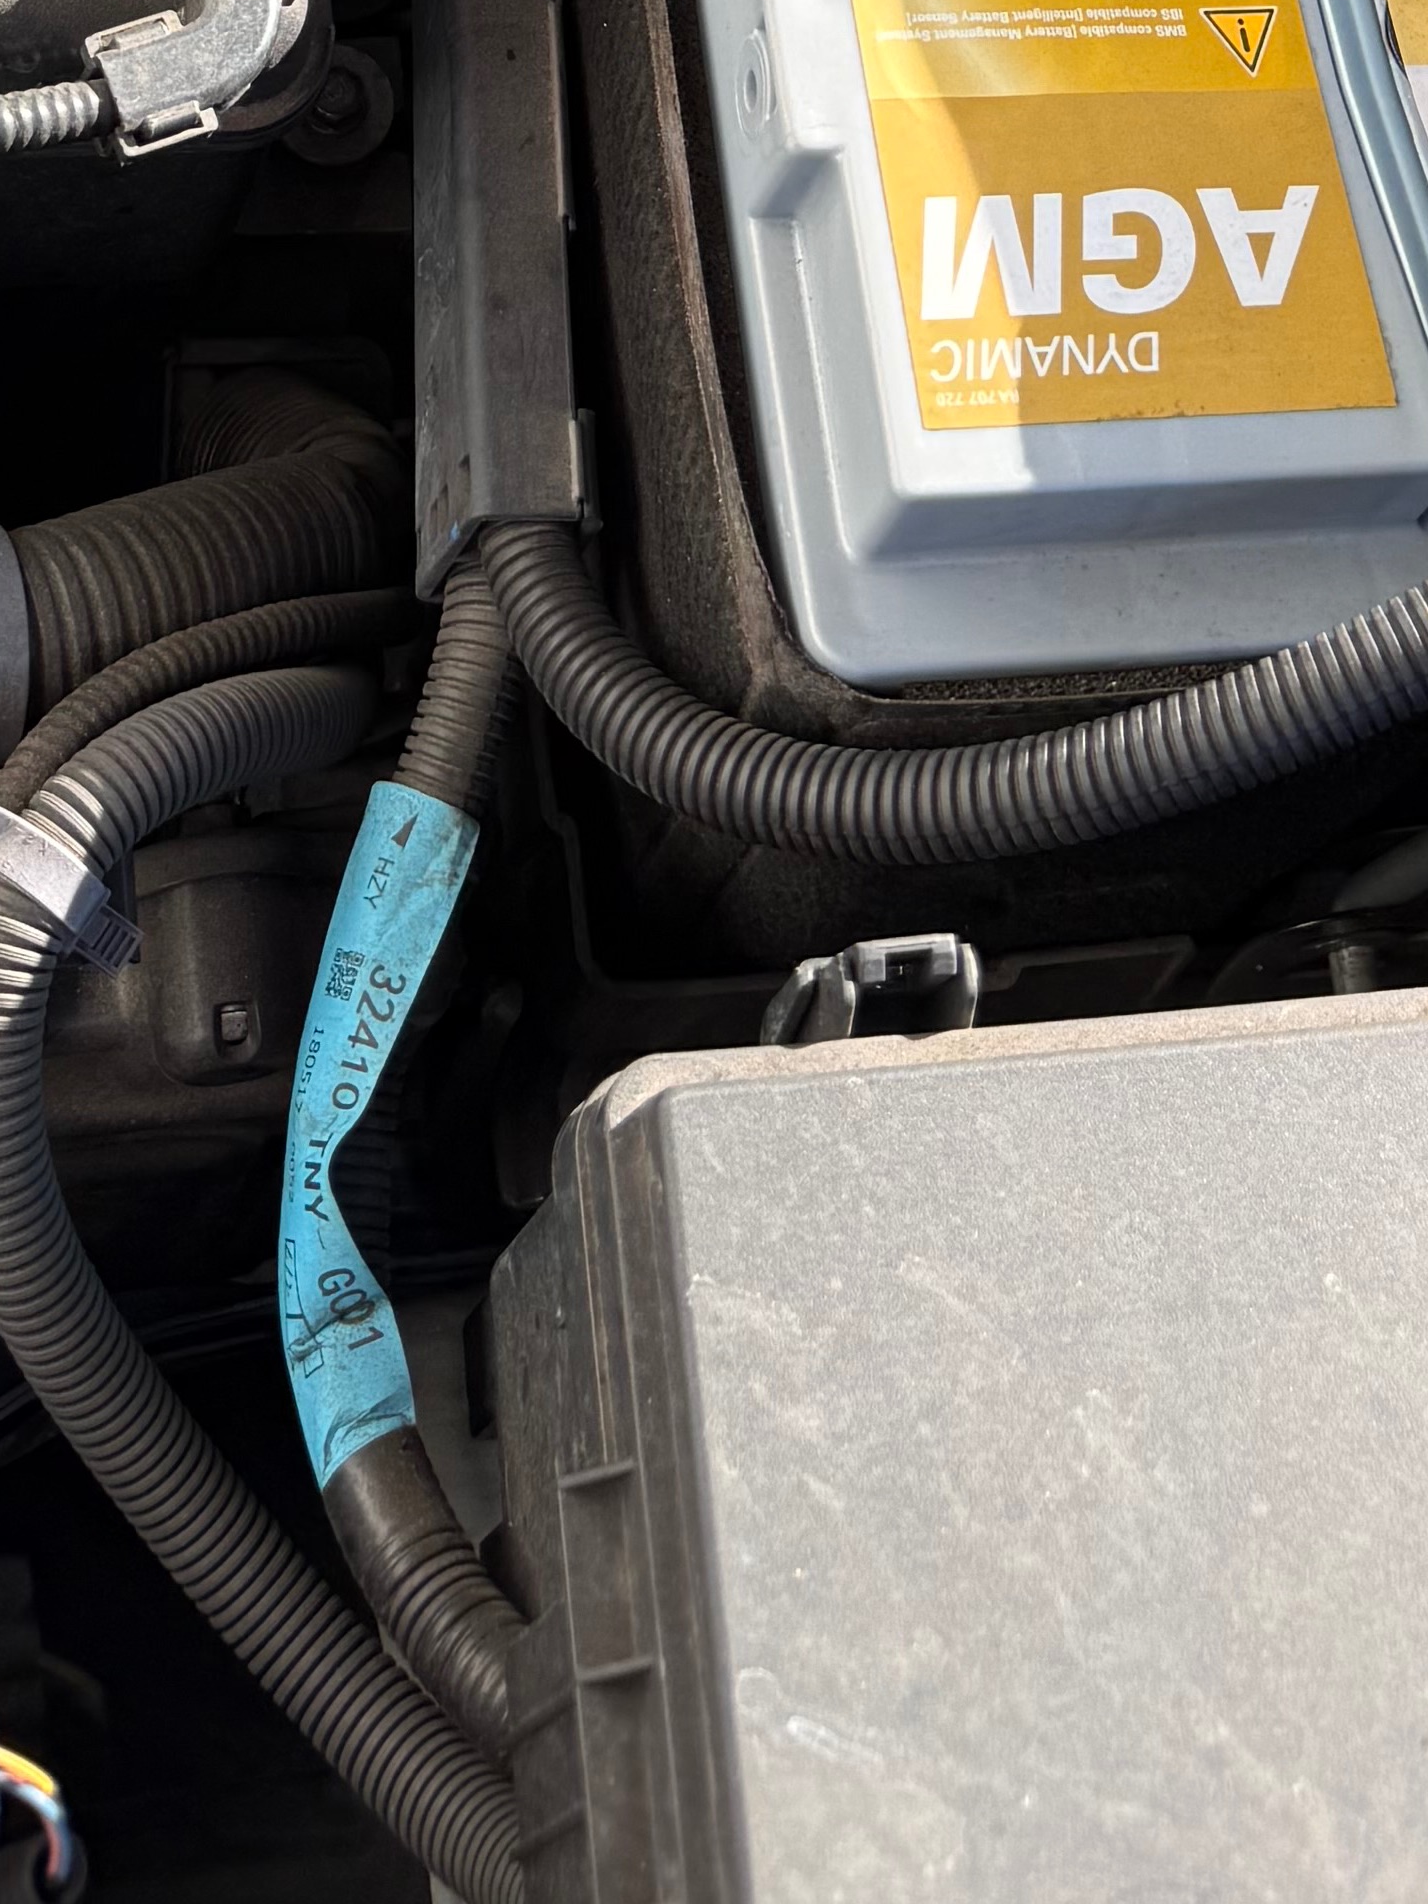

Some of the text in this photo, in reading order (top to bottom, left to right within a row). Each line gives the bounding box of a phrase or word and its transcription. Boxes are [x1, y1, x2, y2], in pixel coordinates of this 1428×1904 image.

[961, 10, 1009, 24] Battery
[1086, 6, 1157, 21] compatible
[1160, 8, 1183, 21] IBS
[933, 26, 1021, 41] Management
[1080, 22, 1152, 38] compatible
[1155, 24, 1187, 37] BMS
[919, 184, 1320, 320] AGM
[930, 331, 1160, 382] DYNAMIC
[969, 390, 996, 406] 707
[363, 856, 395, 909] HZY
[331, 964, 407, 1110] 32410
[303, 1132, 330, 1222] TNY
